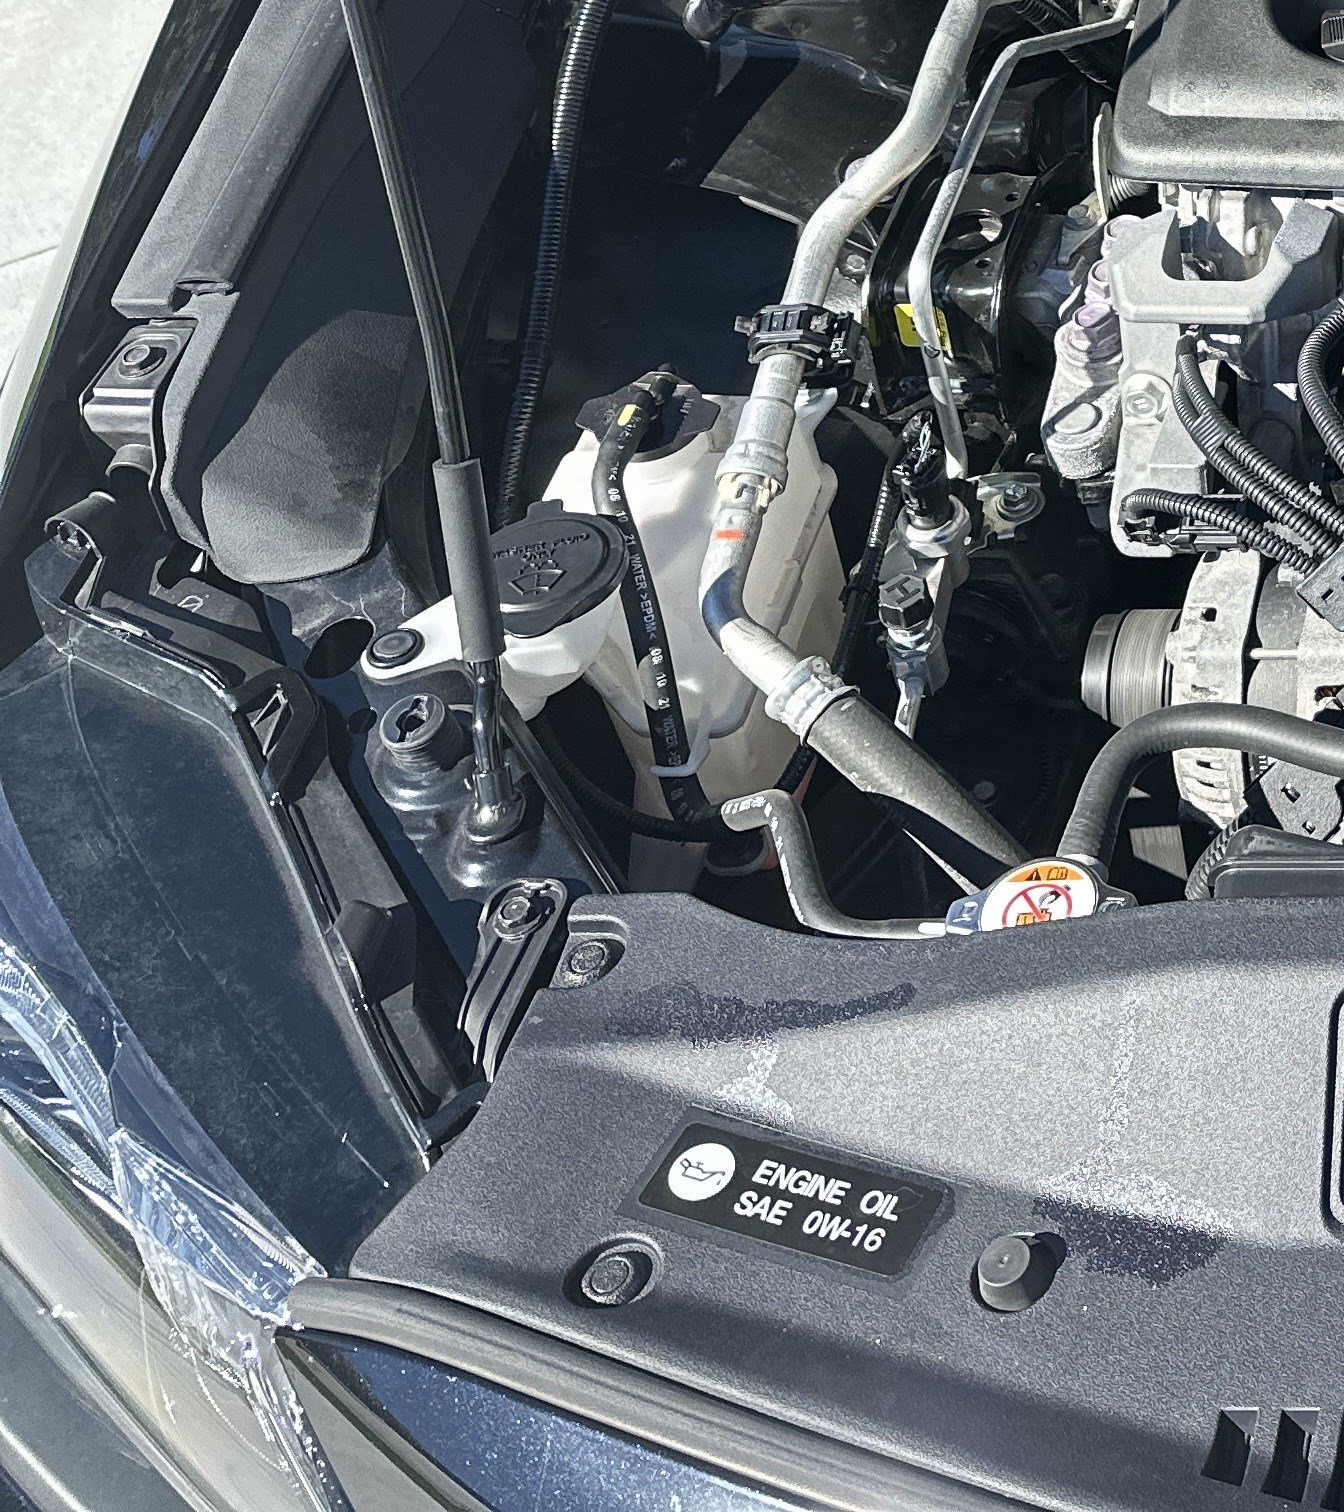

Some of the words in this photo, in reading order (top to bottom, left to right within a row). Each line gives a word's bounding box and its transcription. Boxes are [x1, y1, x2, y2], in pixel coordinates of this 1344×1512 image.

[629, 553, 647, 589] WATER
[733, 1190, 793, 1226] SAE
[802, 1210, 886, 1252] 0W-16
[752, 1159, 852, 1205] ENGINE
[859, 1190, 899, 1221] OIL
